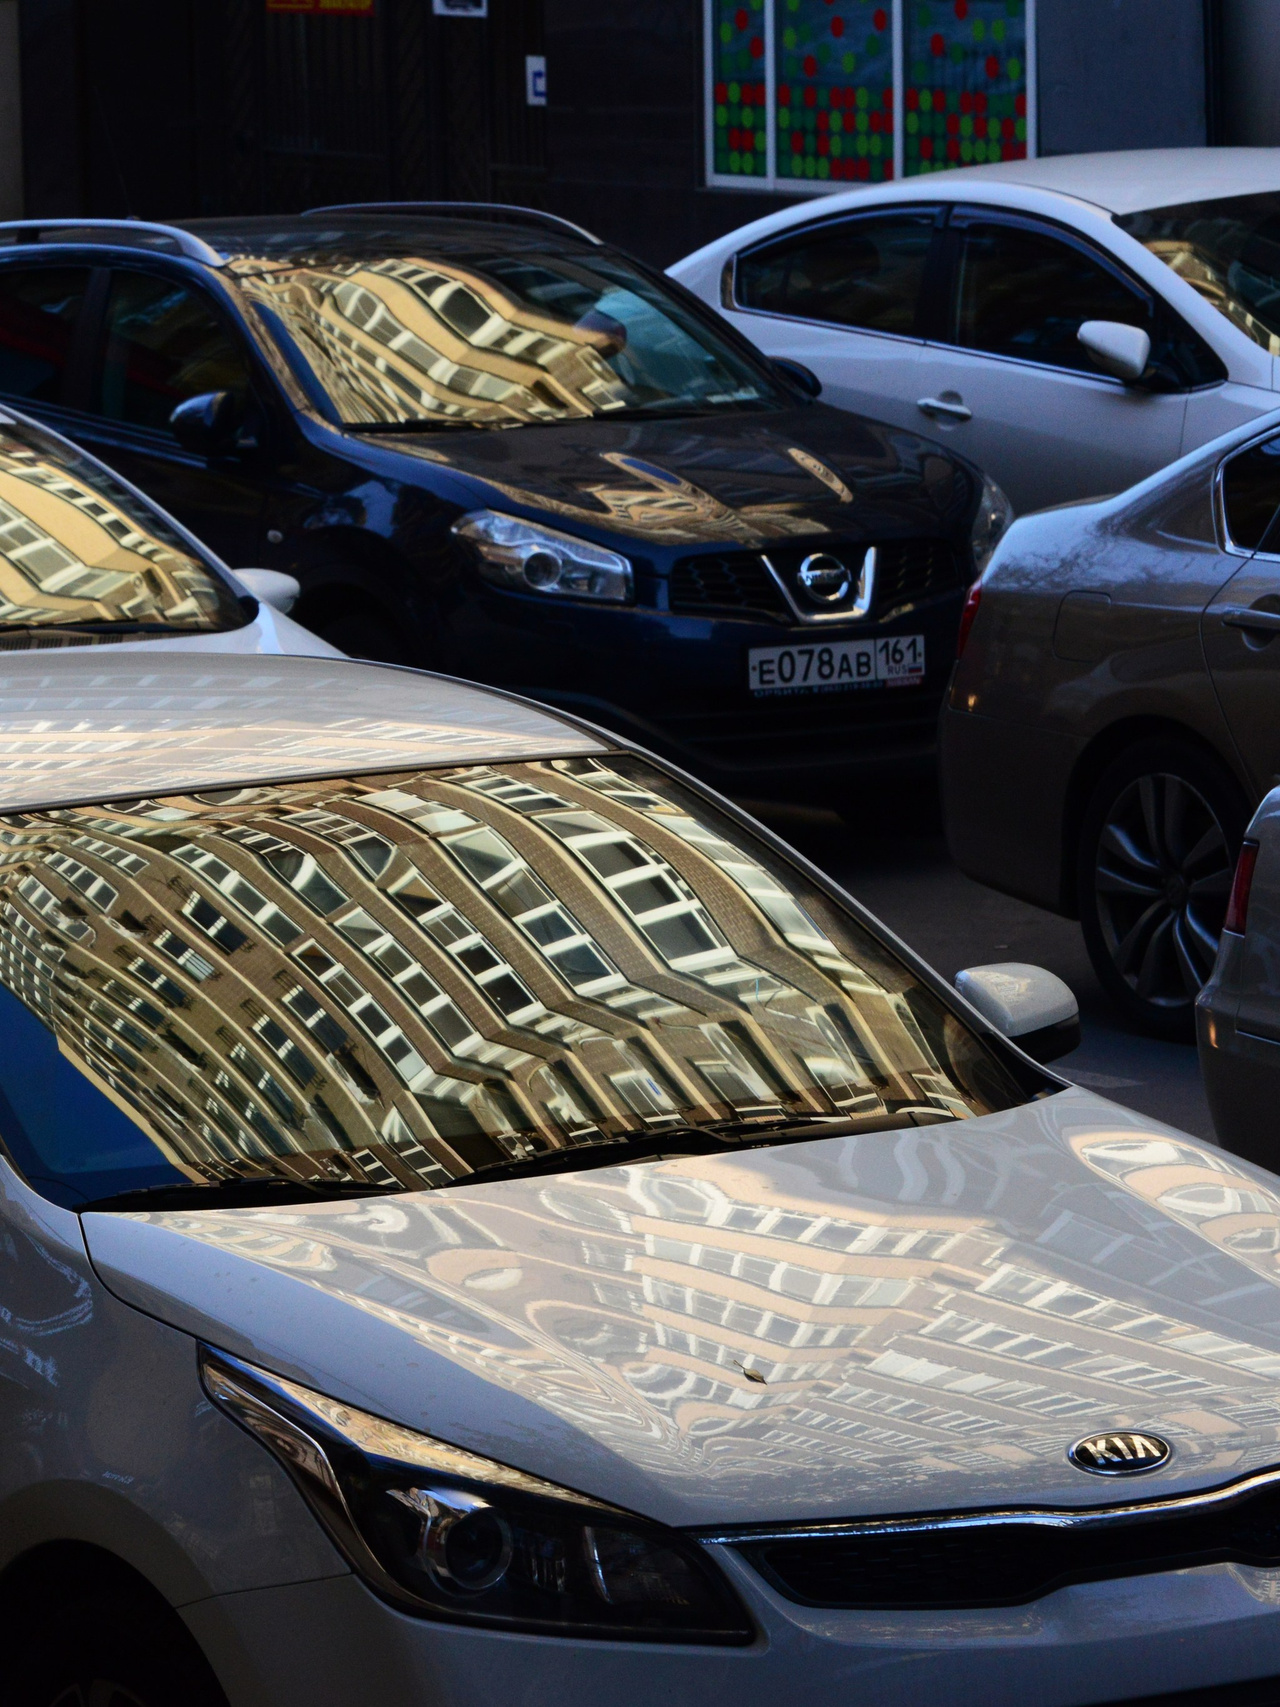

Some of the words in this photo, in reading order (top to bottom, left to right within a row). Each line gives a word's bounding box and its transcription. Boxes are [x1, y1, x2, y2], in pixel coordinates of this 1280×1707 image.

[879, 638, 917, 665] 161
[887, 663, 907, 675] RUS
[1082, 1434, 1162, 1466] KIA
